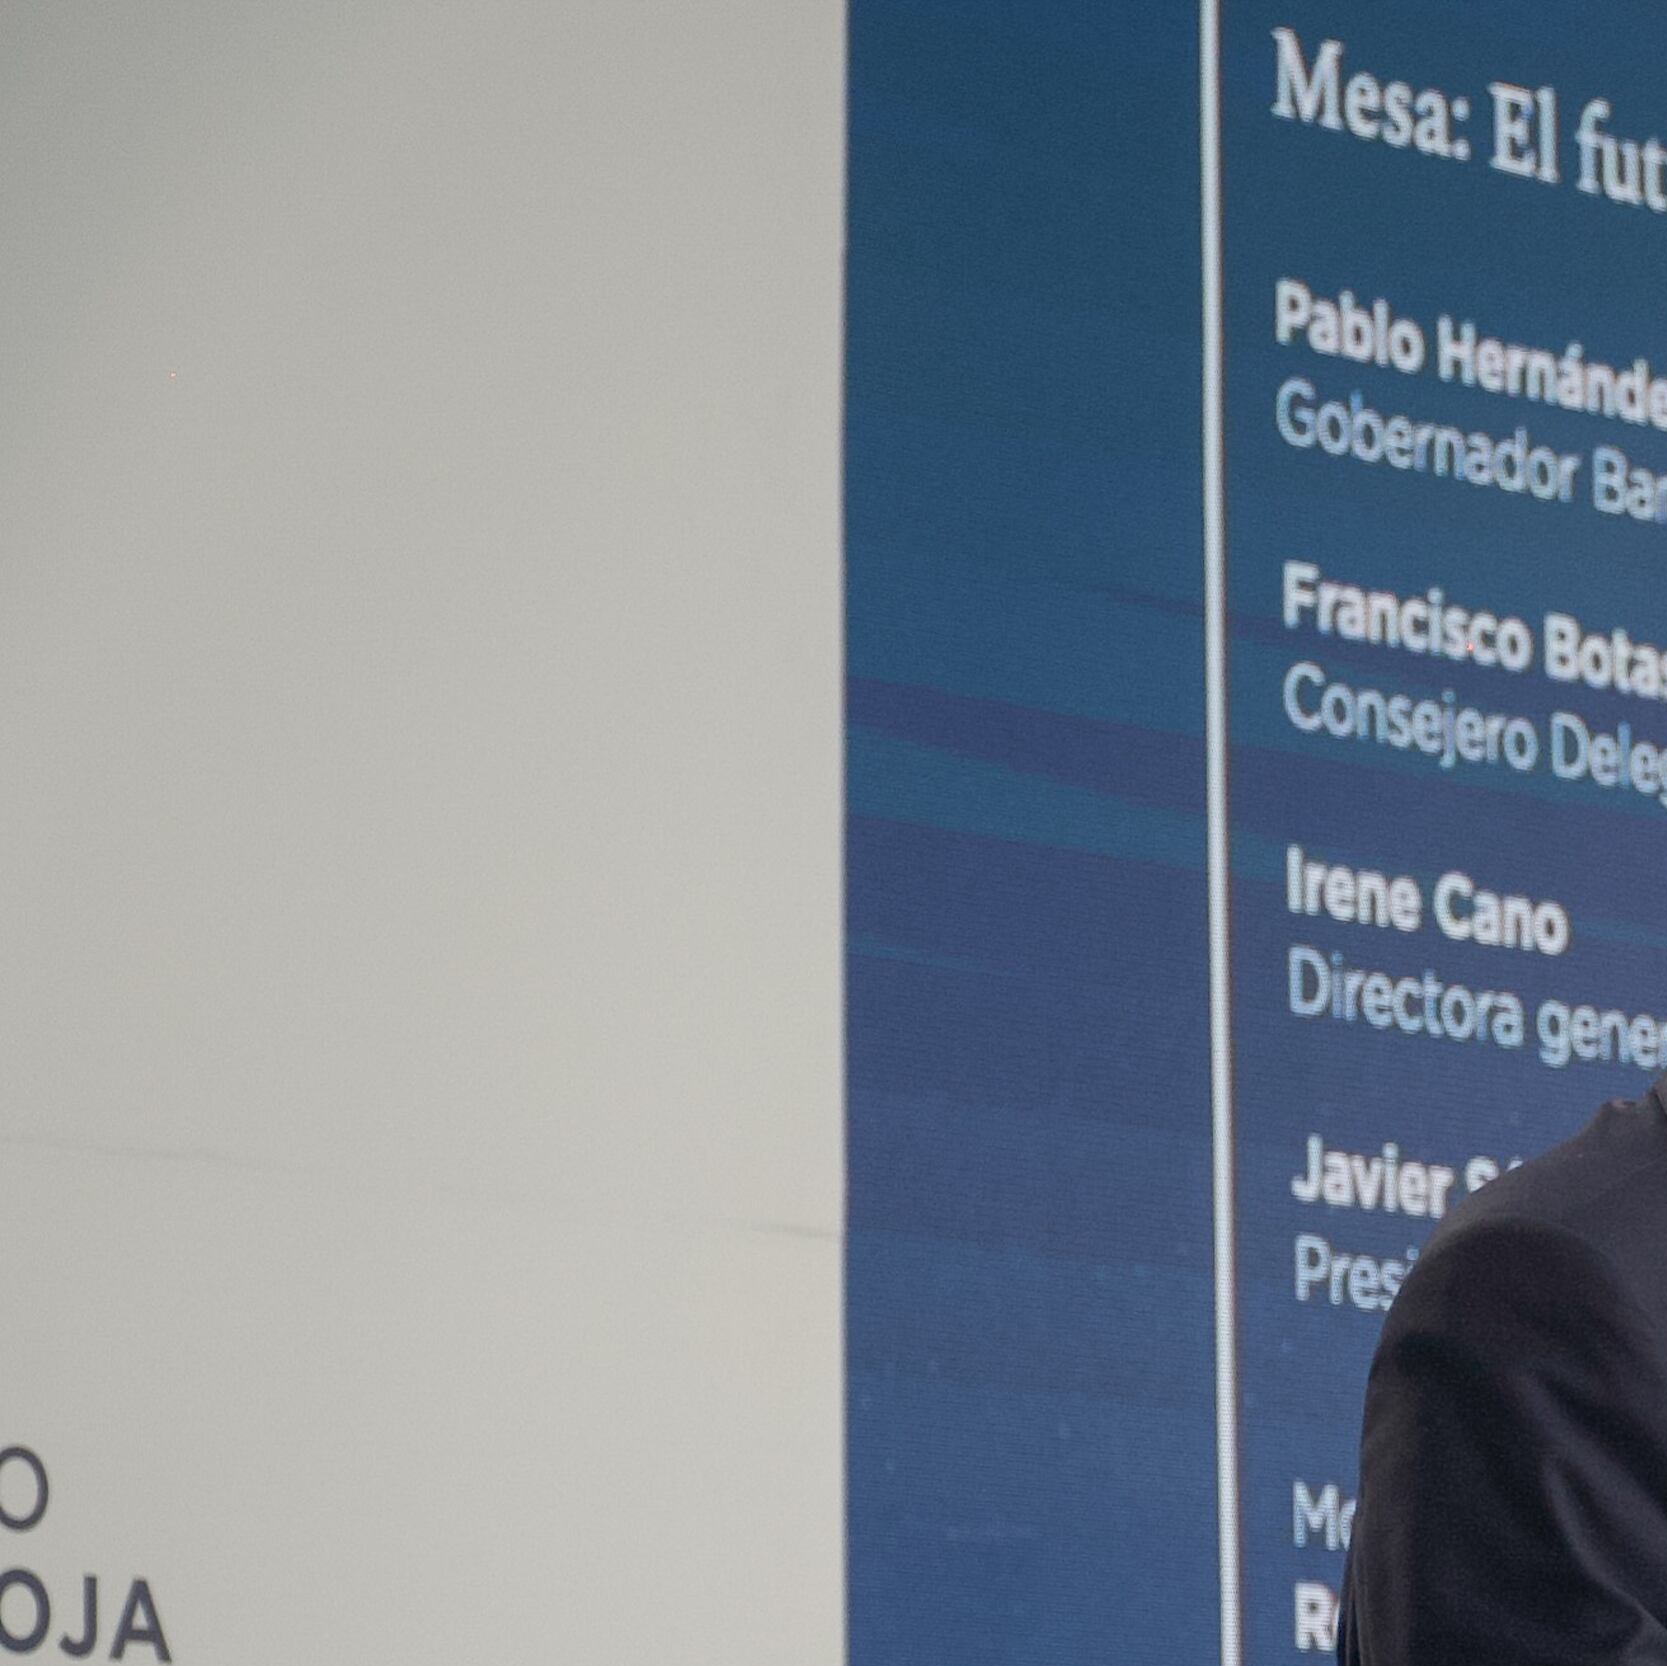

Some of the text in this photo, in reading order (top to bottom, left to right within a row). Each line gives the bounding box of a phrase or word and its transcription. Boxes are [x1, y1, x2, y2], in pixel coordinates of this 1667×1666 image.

[1272, 28, 1472, 161] Mesa:
[1489, 82, 1560, 184] El
[1275, 278, 1424, 374] Pablo
[1275, 377, 1581, 503] Gobernador
[1283, 562, 1533, 672] Francisco
[1283, 661, 1538, 771] Consejero
[1286, 845, 1570, 955] Irene Cano
[1287, 945, 1524, 1047] Directora
[1291, 1132, 1454, 1219] Javier
